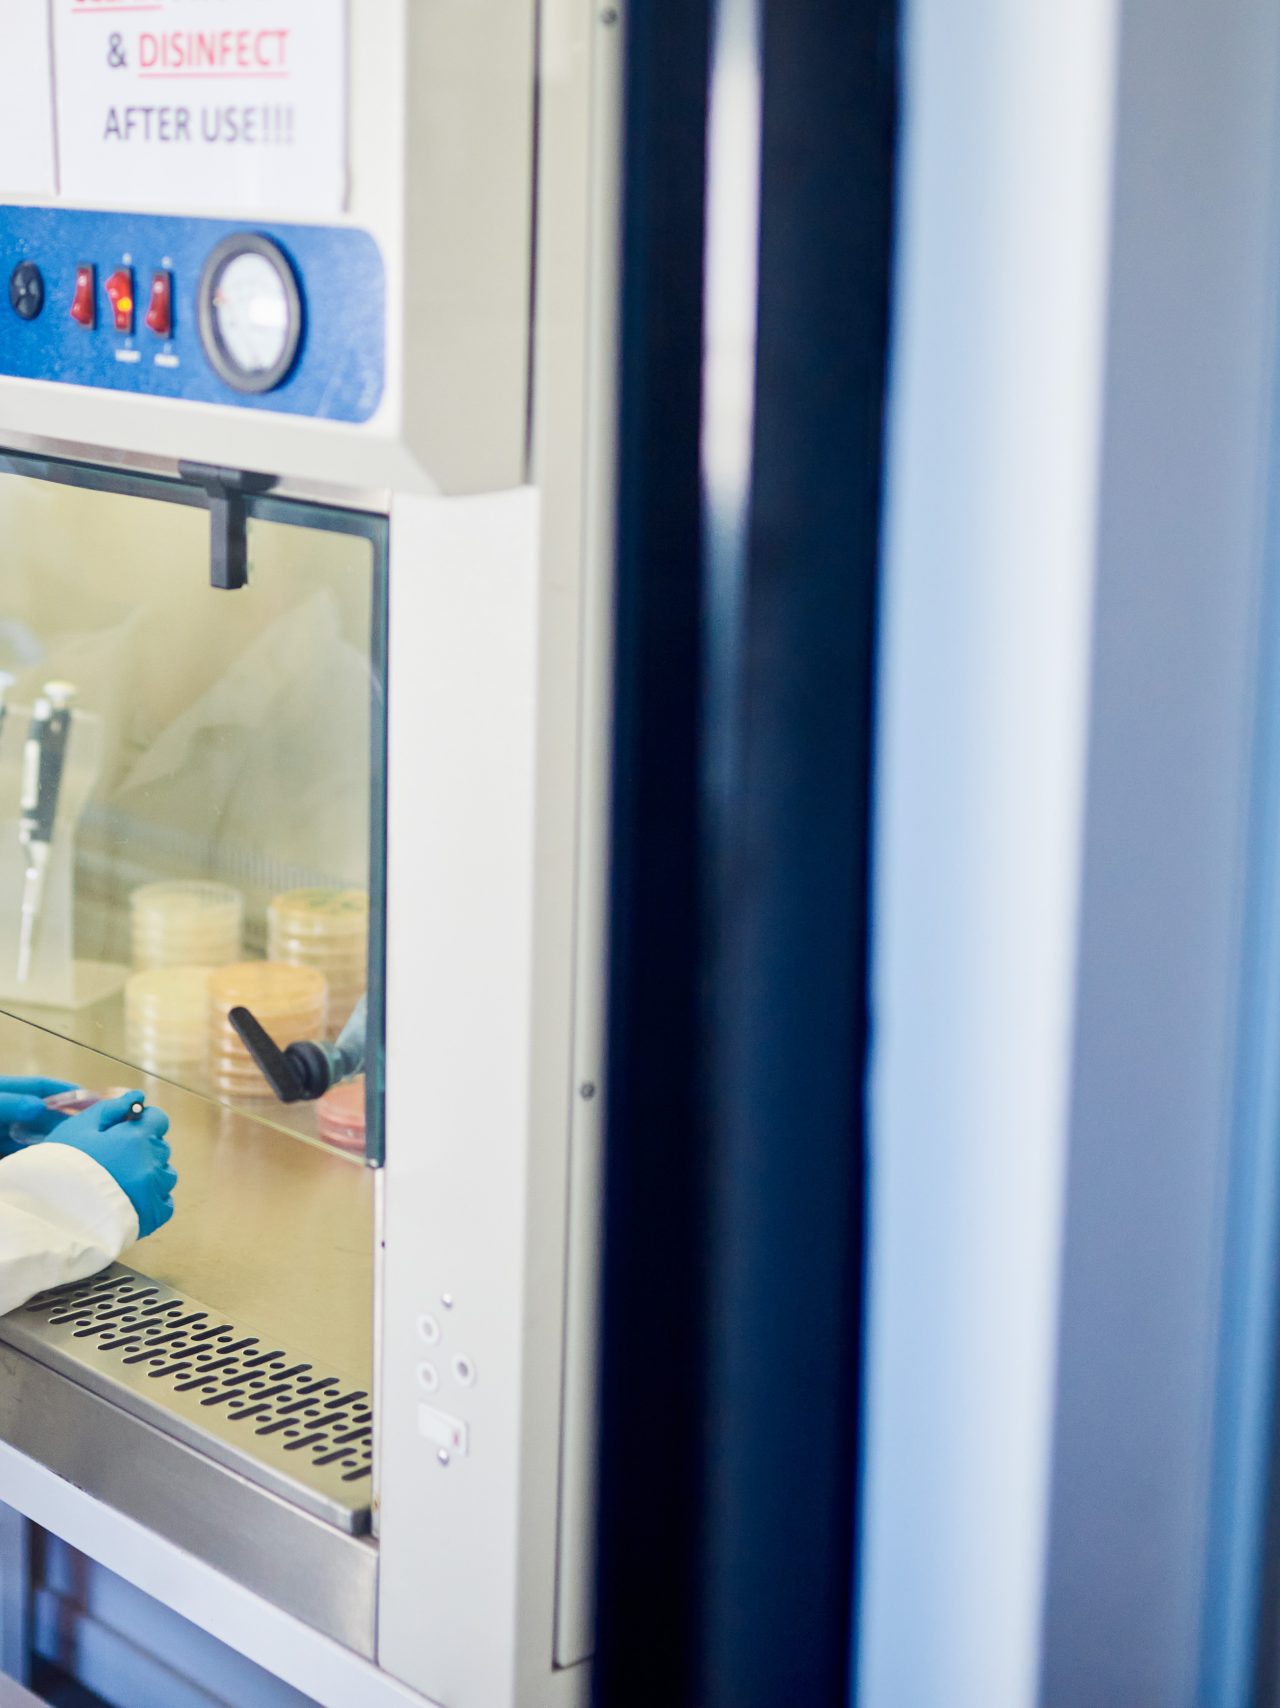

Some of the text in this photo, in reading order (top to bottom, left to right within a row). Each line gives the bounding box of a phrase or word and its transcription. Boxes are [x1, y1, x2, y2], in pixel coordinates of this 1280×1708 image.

[106, 29, 290, 69] & DISINFECT
[104, 105, 295, 144] AFTER USE!!!
